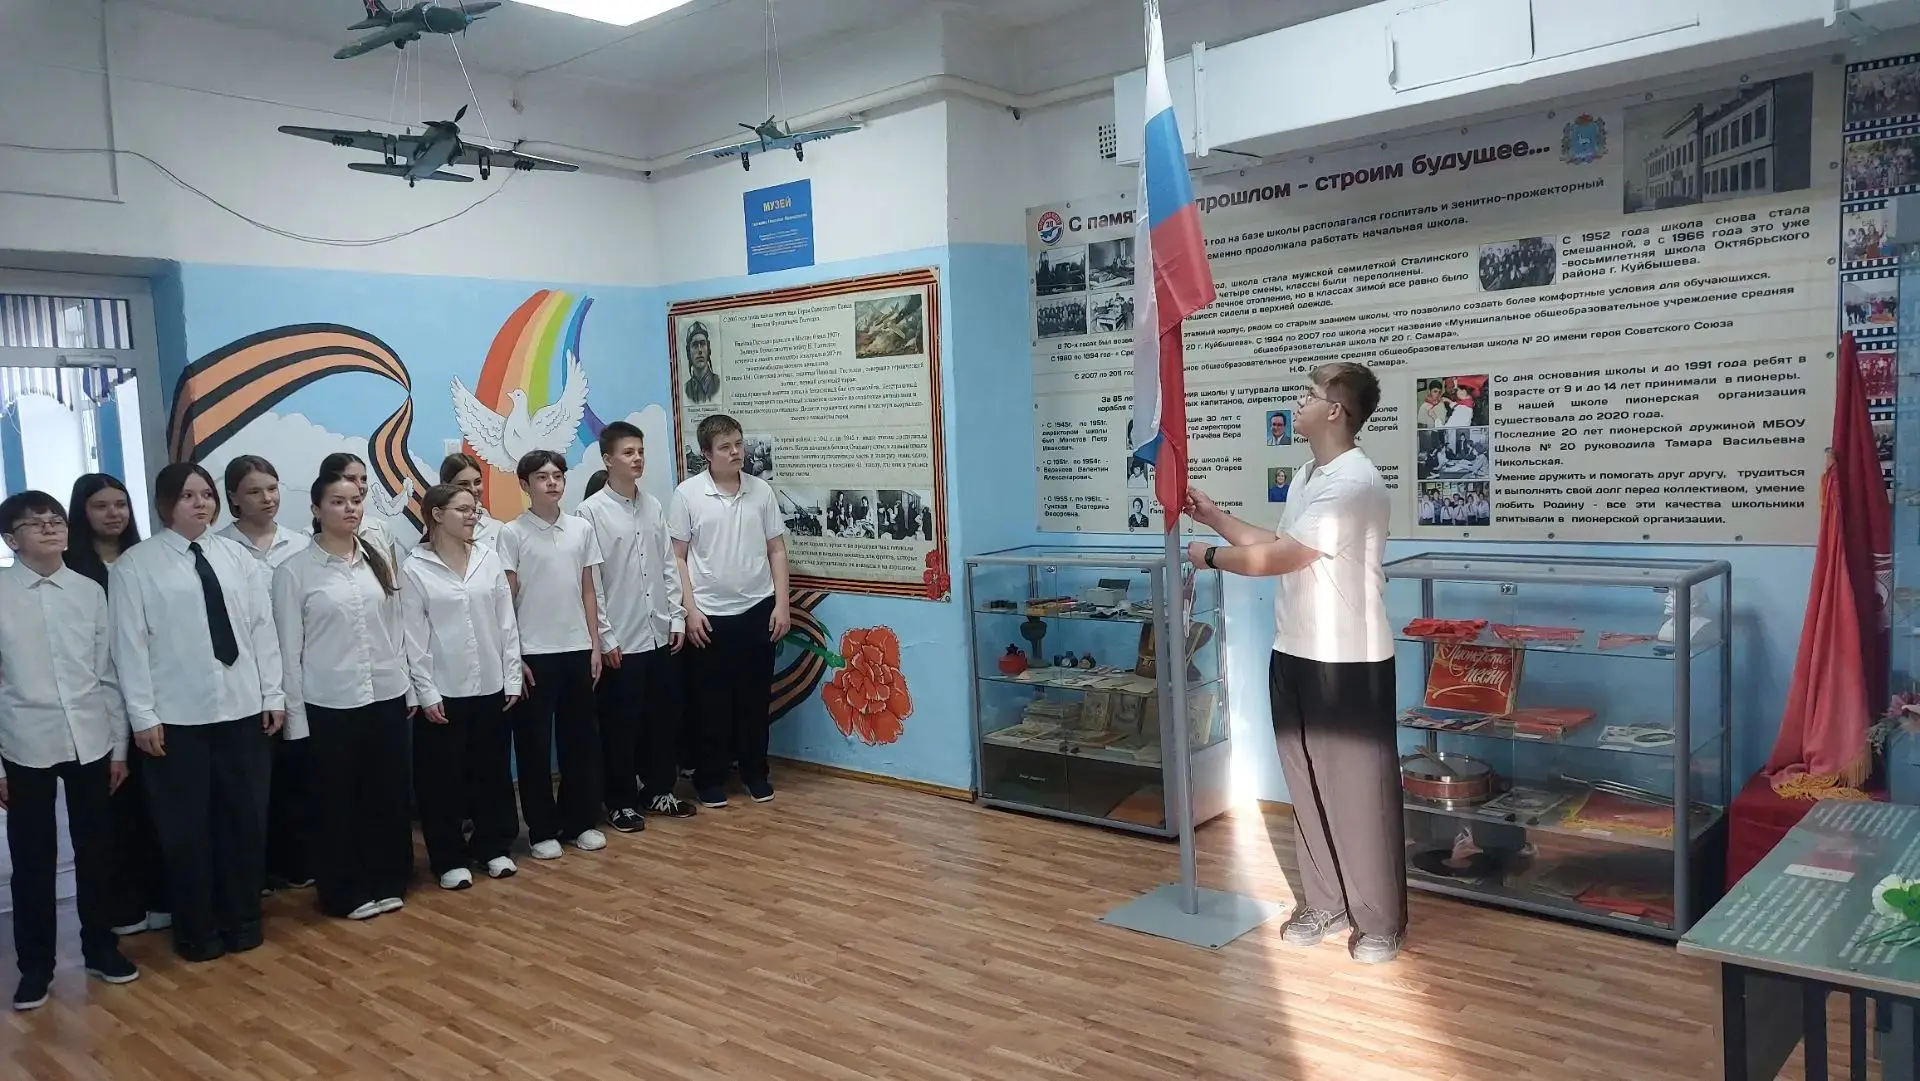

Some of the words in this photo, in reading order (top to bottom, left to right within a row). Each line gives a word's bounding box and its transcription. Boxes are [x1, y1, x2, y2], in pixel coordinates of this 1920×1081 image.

[1069, 216, 1081, 232] С
[1196, 181, 1290, 214] прошлом
[1315, 162, 1403, 191] строим
[1411, 140, 1549, 176] будущее...
[763, 196, 792, 212] МУЗЕЙ
[1210, 237, 1225, 246] год
[1228, 235, 1239, 243] на
[1241, 231, 1264, 240] базе
[1266, 226, 1300, 237] школы
[1302, 214, 1376, 234] располагался
[1379, 205, 1438, 220] госпиталь
[1451, 177, 1603, 209] зенитно-прожекторный
[1562, 235, 1571, 244] С
[1581, 230, 1610, 242] 1952
[1621, 227, 1649, 237] года
[1661, 220, 1703, 232] школа
[1715, 213, 1755, 224] снова
[1768, 206, 1809, 218] стала
[1244, 240, 1306, 256] продолжала
[1310, 232, 1358, 247] работать
[1362, 222, 1422, 238] начальная
[1562, 239, 1636, 256] смешанной,
[1657, 236, 1664, 244] с
[1672, 230, 1704, 242] 1966
[1712, 227, 1742, 237] года
[1750, 223, 1773, 232] это
[1782, 218, 1809, 230] уже
[1664, 244, 1705, 255] школа
[1714, 231, 1810, 249] Октябрьского
[1231, 278, 1258, 287] школа
[1262, 274, 1287, 283] стала
[1292, 267, 1333, 280] мужской
[1337, 258, 1396, 273] семилеткой
[1400, 251, 1468, 265] Сталинского
[1562, 268, 1605, 280] района
[1620, 257, 1700, 272] Куйбышева.
[1410, 304, 1460, 315] позволило
[1463, 300, 1503, 309] создать
[1505, 296, 1536, 305] более
[1539, 289, 1605, 301] комфортные
[1608, 284, 1655, 296] условия
[1658, 281, 1679, 289] для
[1378, 341, 1484, 356] общеобразовательная
[1522, 336, 1532, 344] №
[1535, 334, 1550, 342] 20
[1553, 332, 1587, 341] имени
[1590, 329, 1621, 339] героя
[1624, 324, 1690, 335] Советского
[1693, 320, 1733, 329] Союза
[1494, 374, 1508, 382] Со
[1538, 369, 1600, 380] основания
[1604, 366, 1645, 375] школы
[1684, 360, 1711, 370] 1991
[1717, 359, 1746, 368] года
[1753, 355, 1792, 367] ребят
[1494, 388, 1545, 397] возрасте
[1564, 384, 1571, 392] 9
[1603, 382, 1616, 390] 14
[1644, 377, 1716, 389] принимали
[1736, 372, 1800, 382] пионеры.
[1518, 399, 1554, 409] нашей
[1570, 398, 1608, 406] школе
[1625, 393, 1698, 404] пионерская
[1718, 388, 1805, 400] организация
[1367, 423, 1398, 432] Сергей
[1494, 415, 1575, 426] существовала
[1596, 411, 1629, 420] 2020
[1494, 430, 1555, 438] Последние
[1561, 427, 1577, 436] 20
[1609, 423, 1682, 434] пионерской
[1688, 420, 1755, 432] дружиной
[1762, 418, 1805, 428] МБОУ
[1494, 444, 1531, 452] Школа
[1539, 443, 1551, 451] №
[1559, 442, 1576, 450] 20
[1584, 441, 1655, 451] руководила
[1664, 438, 1712, 448] Тамара
[1722, 436, 1805, 445] Васильевна
[1494, 458, 1563, 466] Никольская.
[1494, 473, 1535, 481] Умение
[1538, 473, 1586, 482] дружить
[1599, 471, 1654, 479] помогать
[1657, 471, 1685, 480] друг
[1688, 470, 1726, 479] другу,
[1737, 469, 1804, 478] трудиться
[1565, 486, 1592, 494] свой
[1624, 486, 1659, 495] перед
[1663, 485, 1747, 493] коллективом,
[1755, 485, 1804, 494] умение
[1495, 500, 1534, 508] любить
[1543, 500, 1584, 510] Родину
[1571, 514, 1639, 524] пионерской
[1642, 516, 1725, 525] организации.
